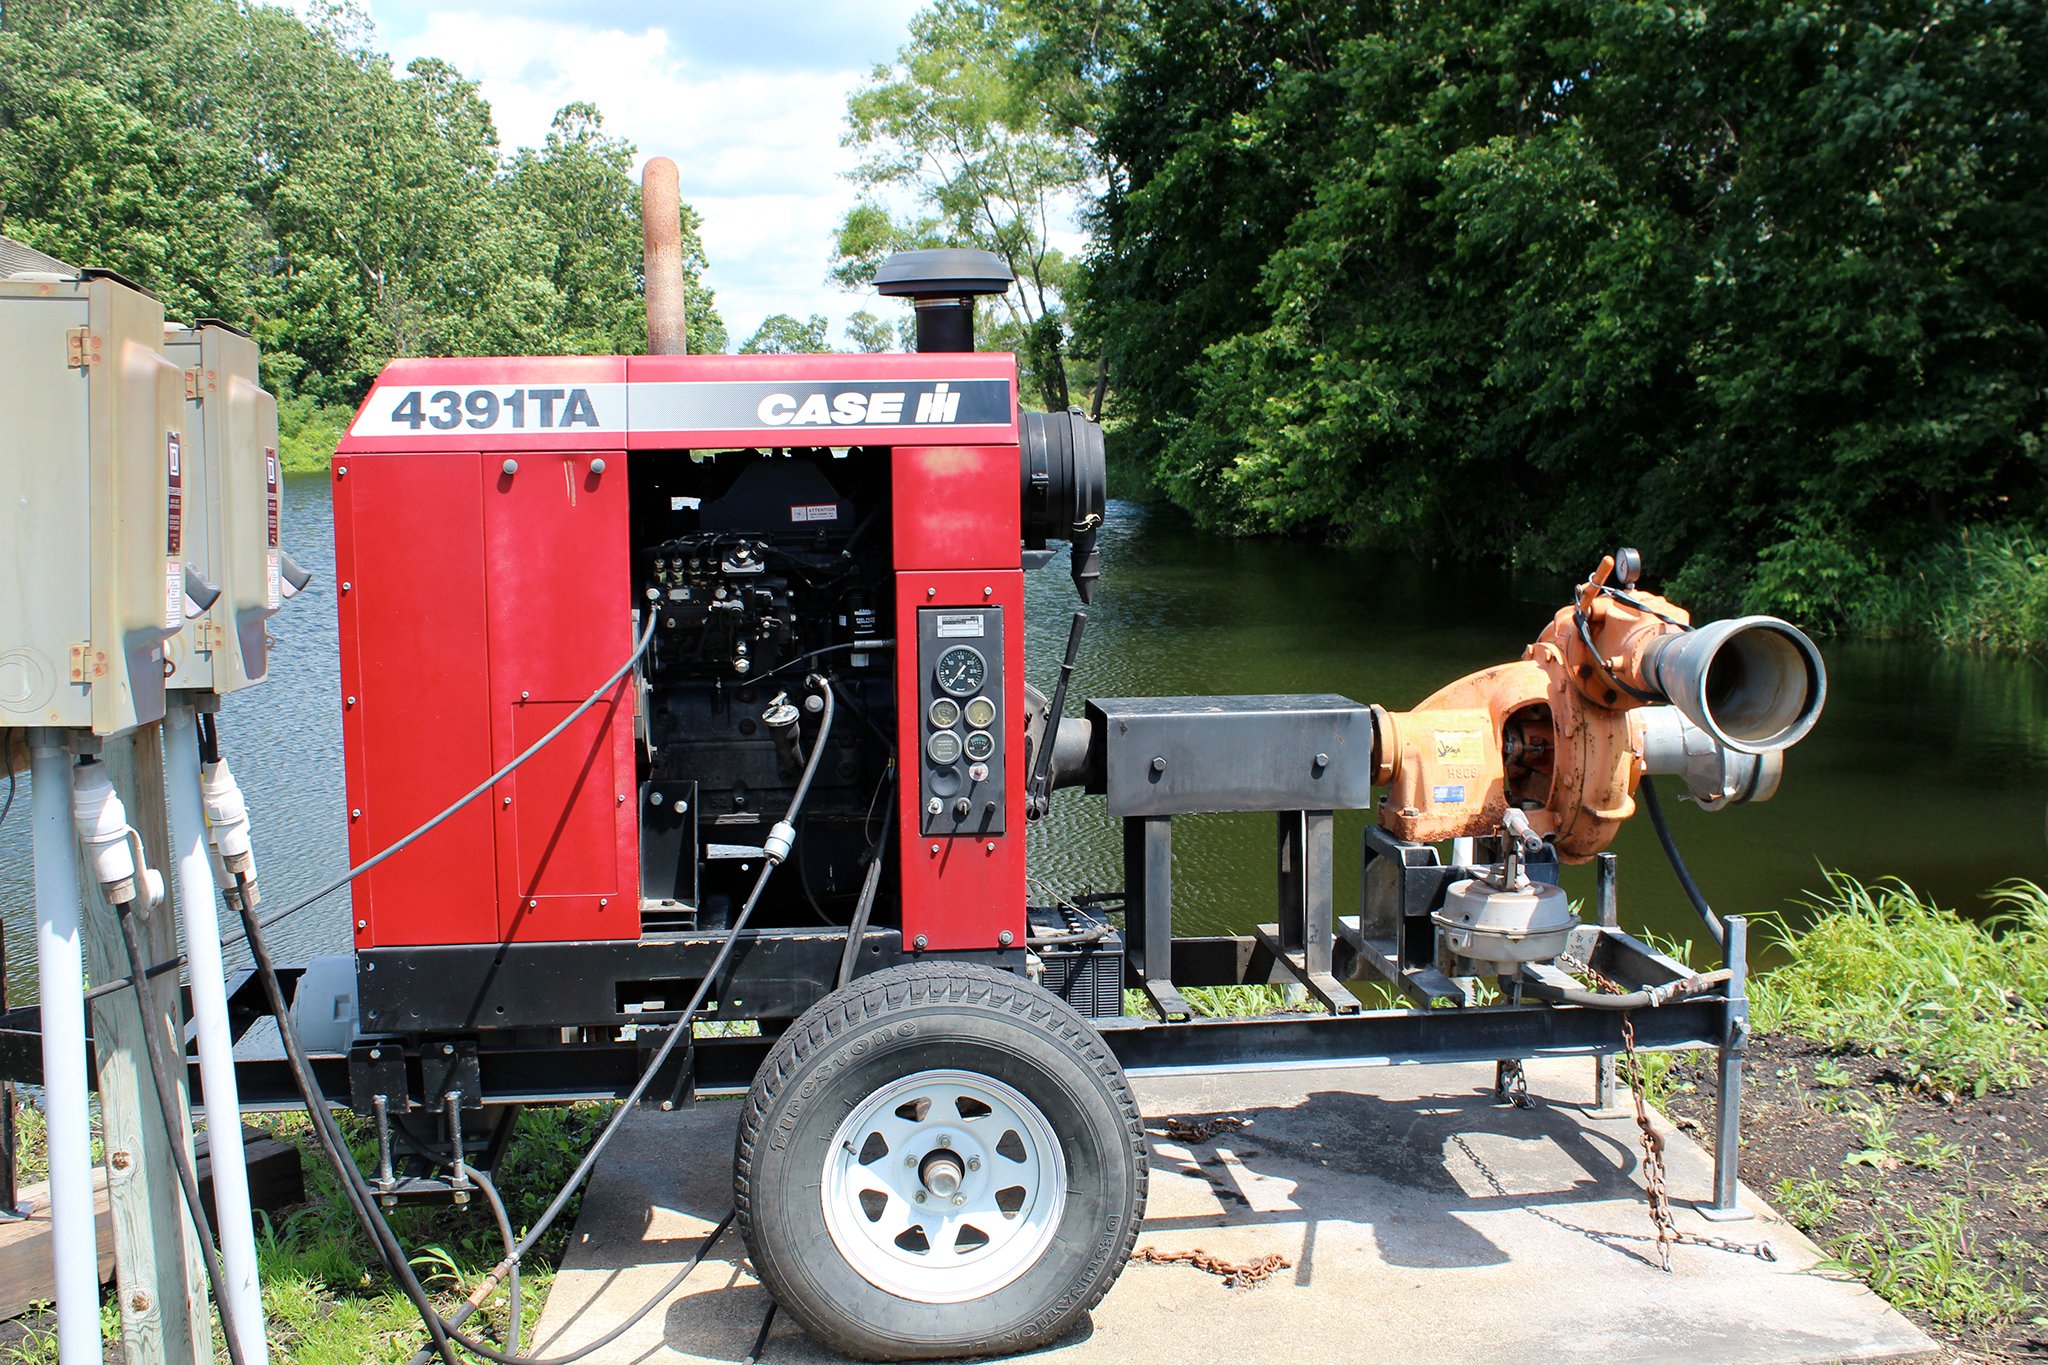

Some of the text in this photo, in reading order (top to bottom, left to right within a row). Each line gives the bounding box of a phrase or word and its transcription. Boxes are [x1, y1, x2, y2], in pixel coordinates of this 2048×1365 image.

[391, 389, 600, 430] 4391TA
[757, 392, 906, 426] CASE
[770, 1021, 917, 1151] Firestone
[1003, 1214, 1121, 1344] DESTINATION
